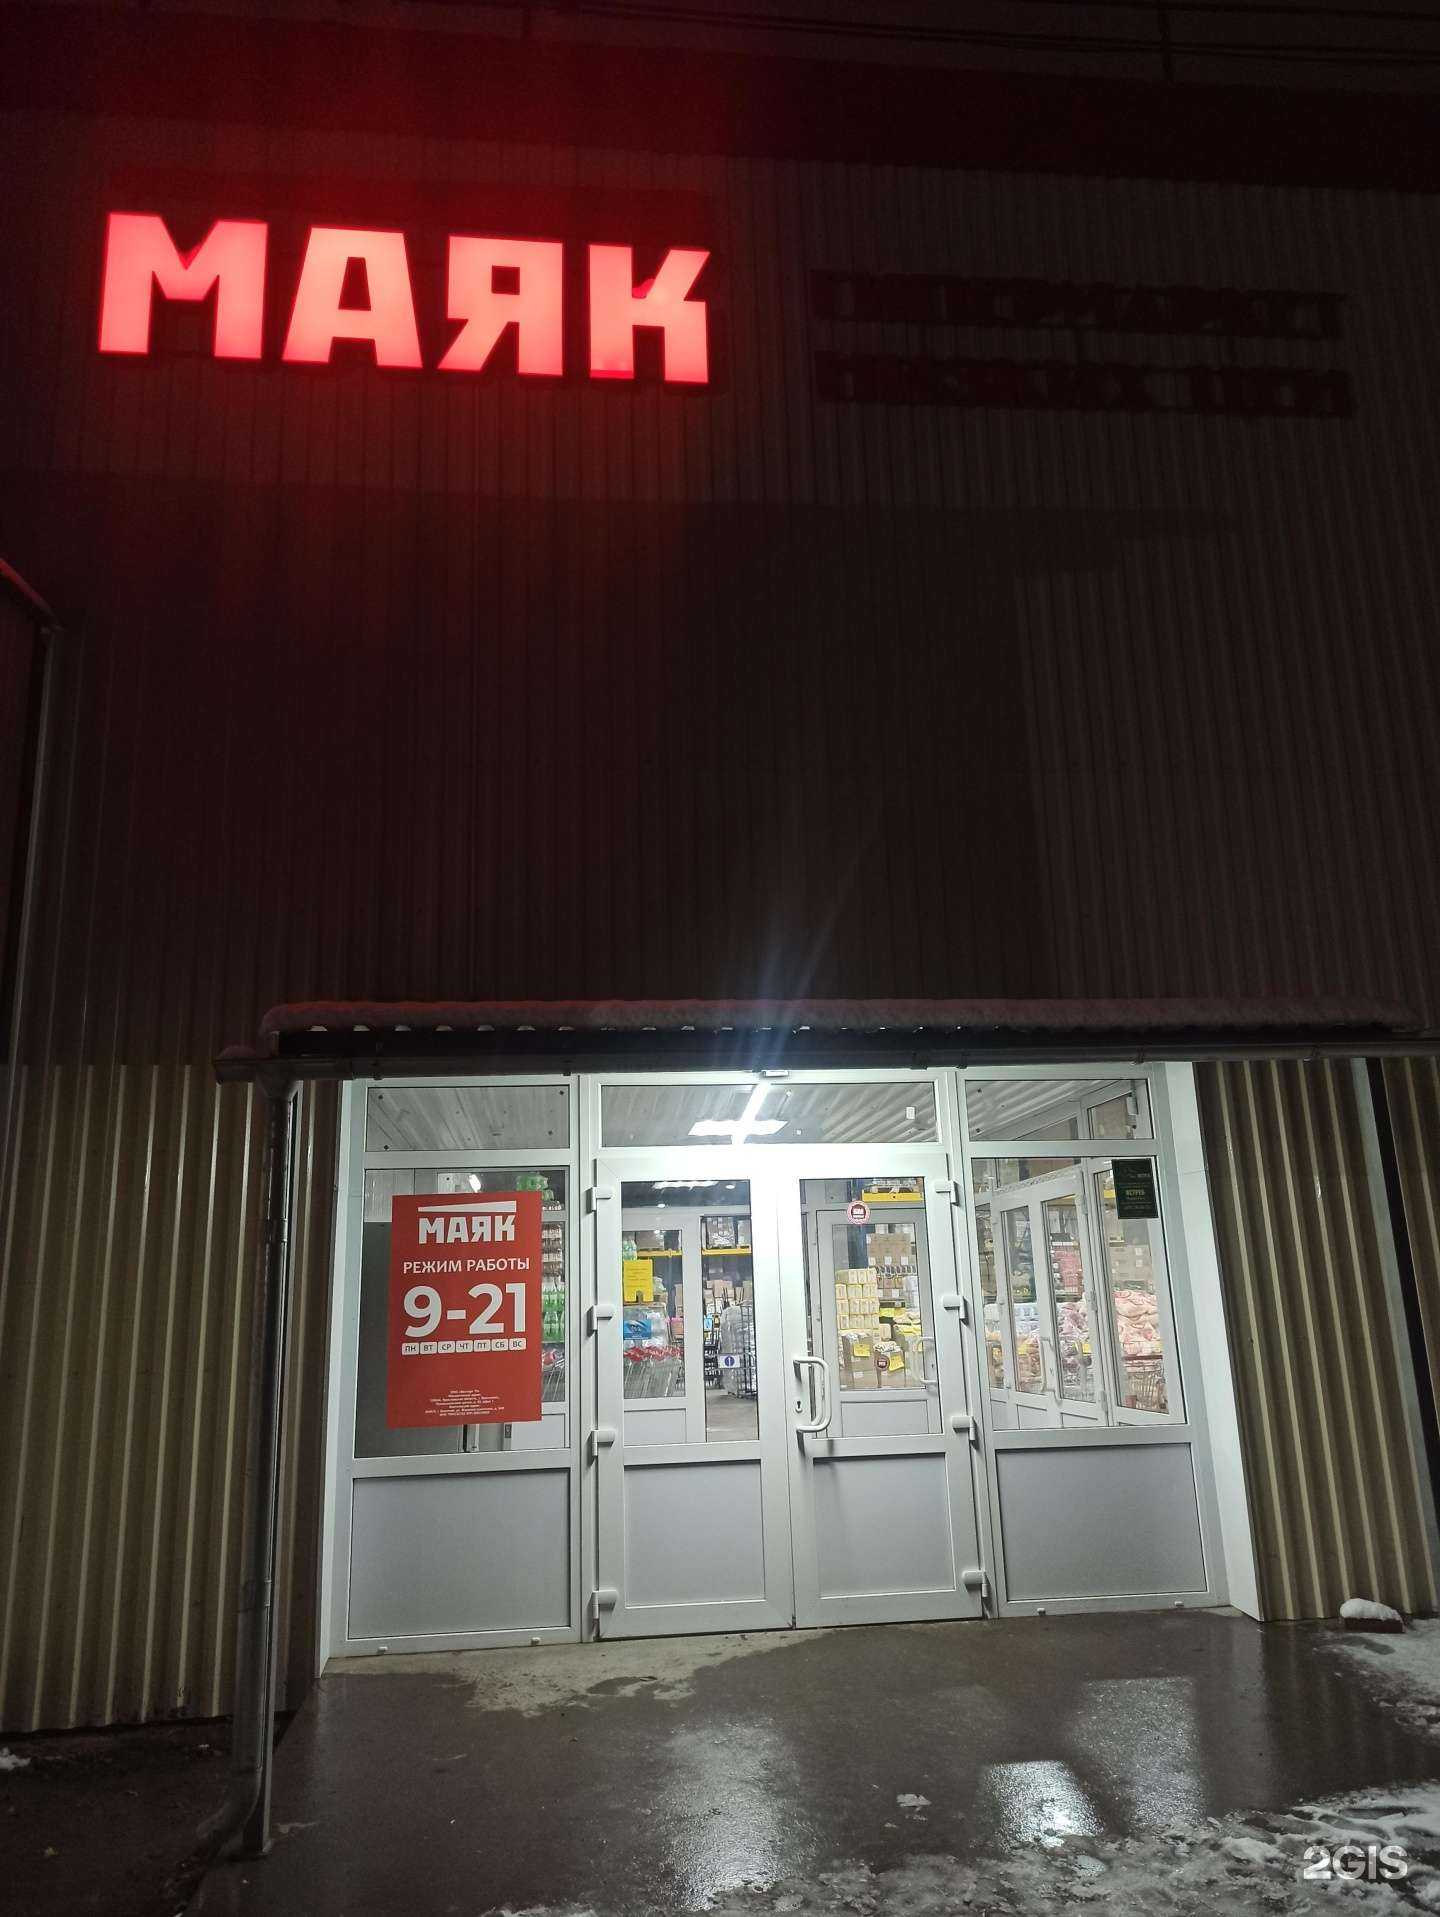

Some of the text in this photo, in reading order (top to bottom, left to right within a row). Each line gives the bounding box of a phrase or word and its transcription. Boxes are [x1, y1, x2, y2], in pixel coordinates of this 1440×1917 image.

[97, 211, 711, 385] МАЯК
[418, 1214, 515, 1245] МАЯК
[402, 1257, 530, 1274] РЕЖИМ РАБОТЫ
[403, 1282, 527, 1338] 9-21
